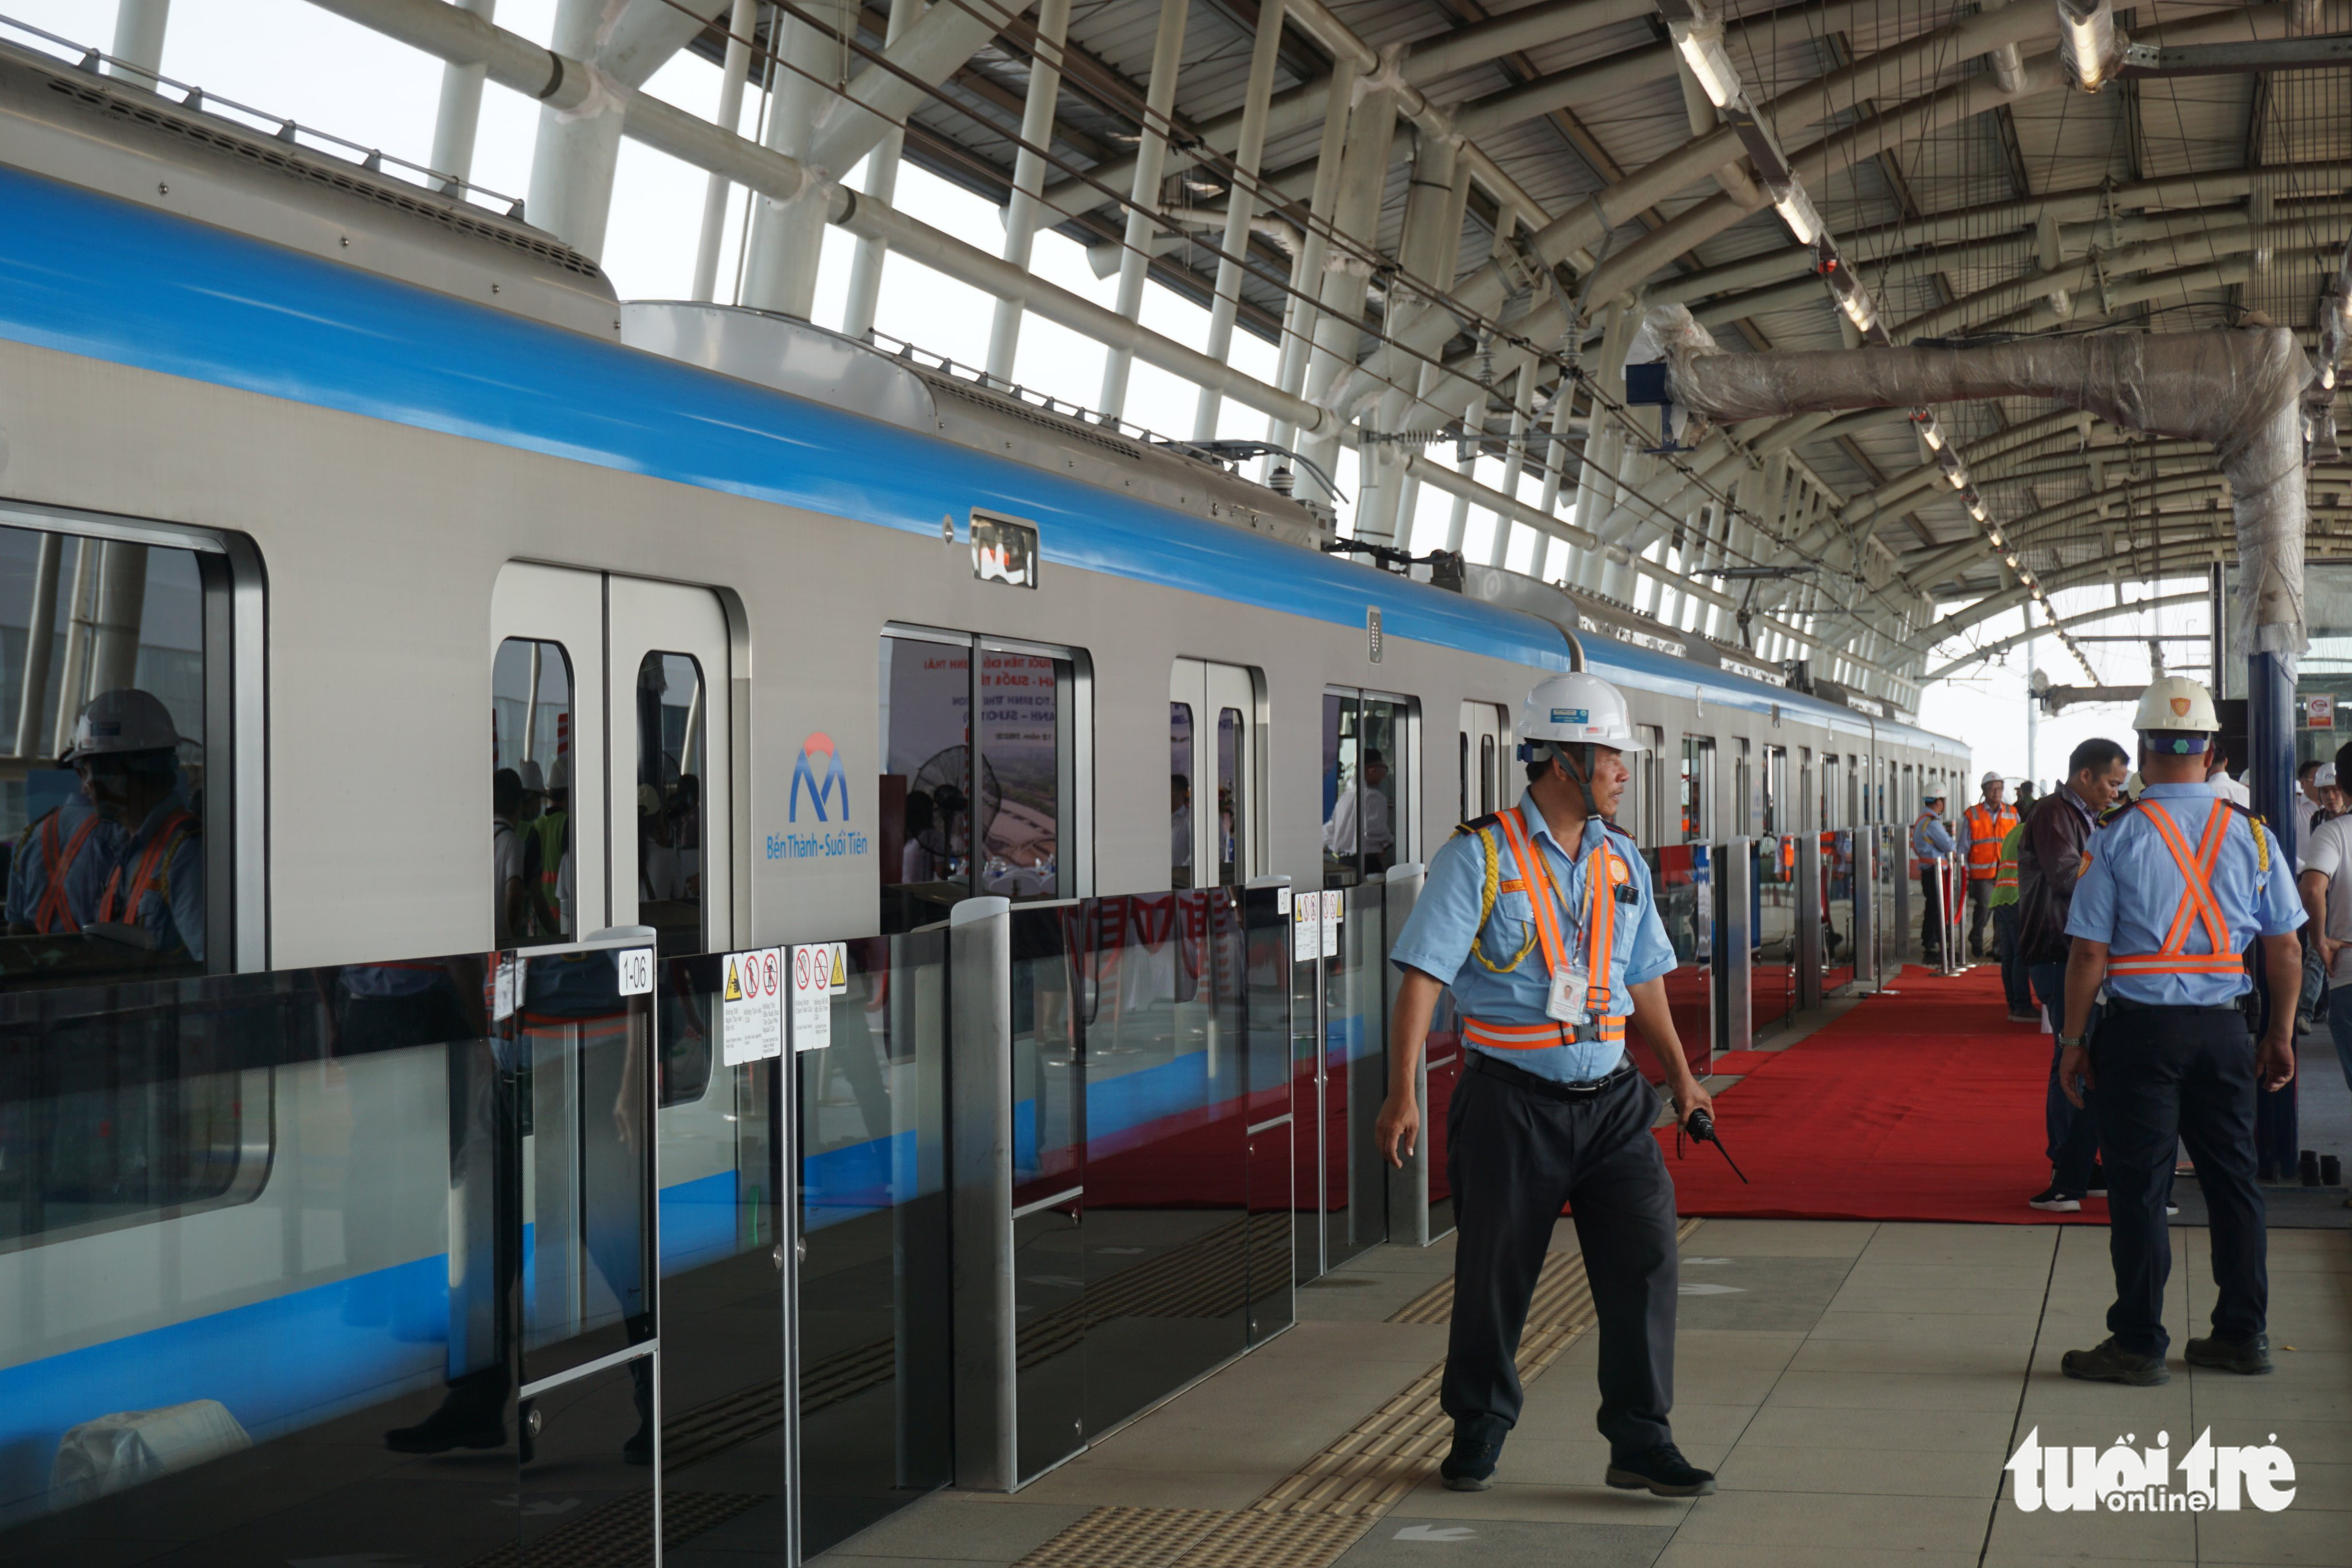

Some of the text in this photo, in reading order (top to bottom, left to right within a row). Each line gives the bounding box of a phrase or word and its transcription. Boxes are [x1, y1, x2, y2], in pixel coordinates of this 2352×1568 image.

[767, 832, 786, 859] Bến
[787, 833, 818, 858] Thành
[825, 829, 846, 856] Suối
[624, 956, 646, 990] 1-06
